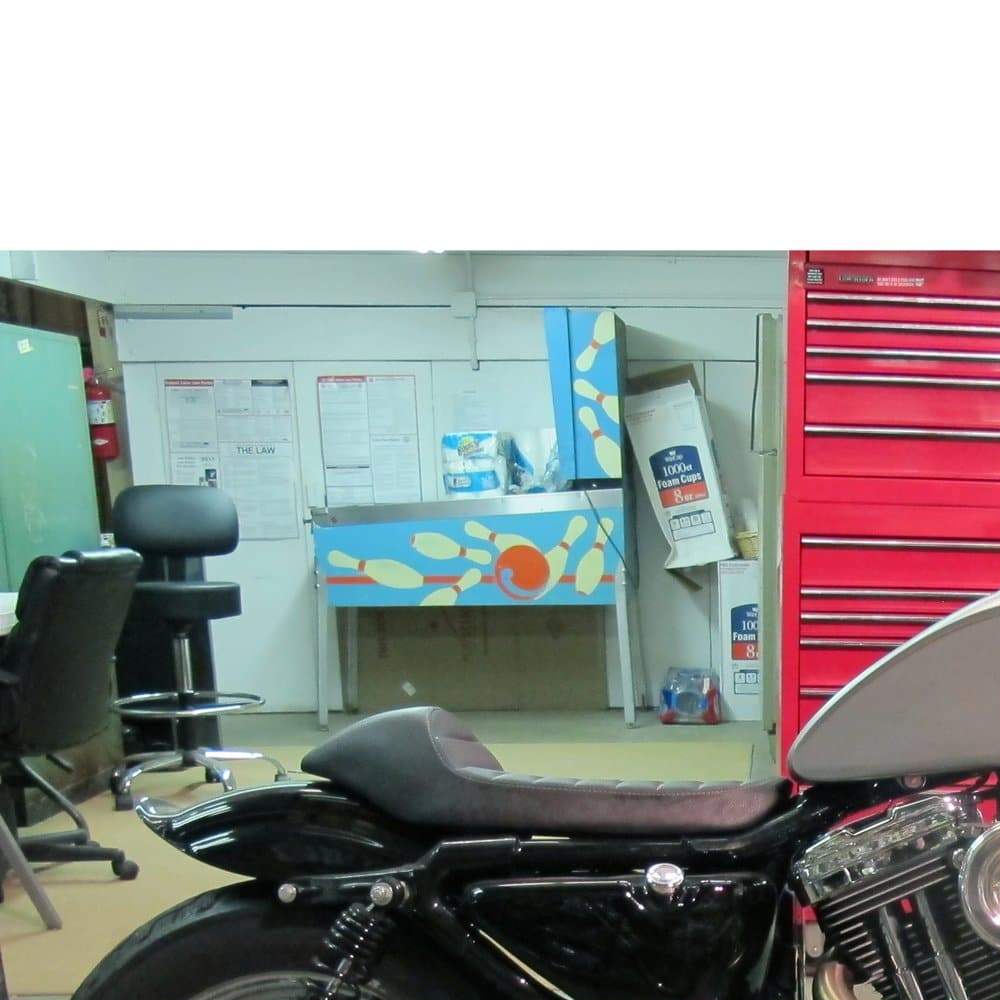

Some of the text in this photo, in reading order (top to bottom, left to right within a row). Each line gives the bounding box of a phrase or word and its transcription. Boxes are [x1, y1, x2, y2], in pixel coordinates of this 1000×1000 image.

[236, 446, 276, 455] THE LAW
[657, 471, 703, 490] Foam Cups
[673, 488, 684, 505] 8
[732, 632, 757, 642] Foam
